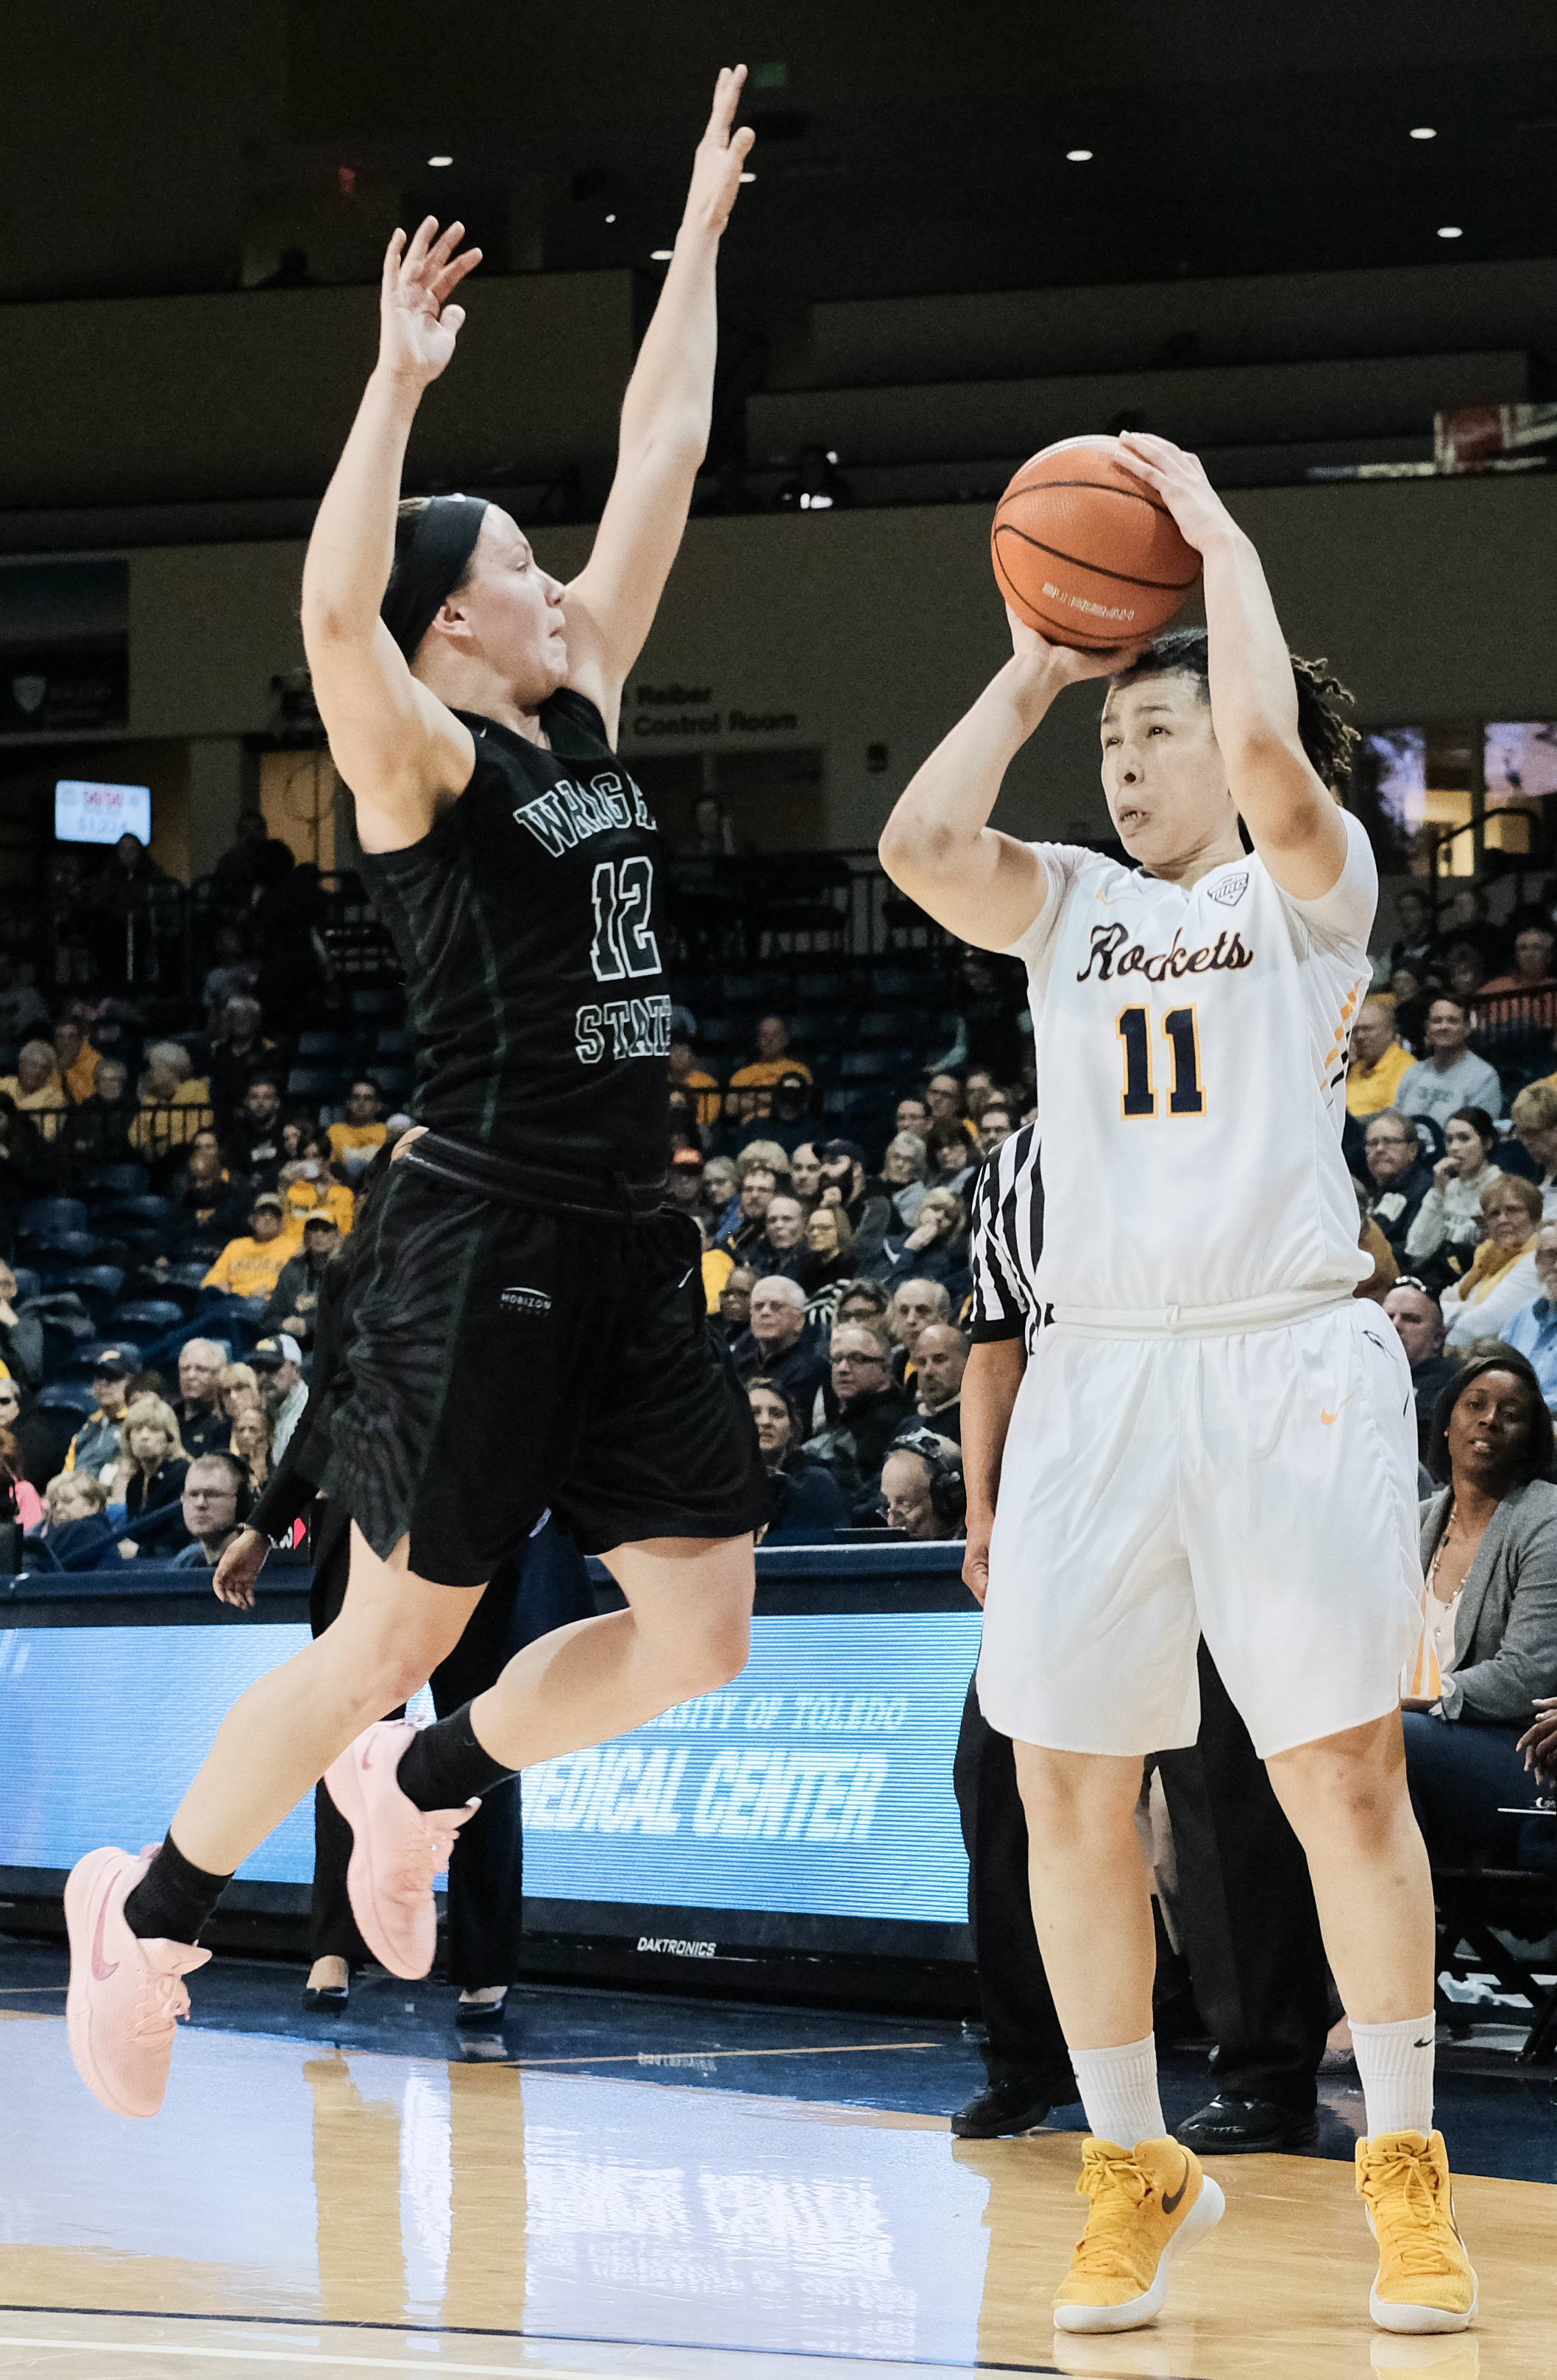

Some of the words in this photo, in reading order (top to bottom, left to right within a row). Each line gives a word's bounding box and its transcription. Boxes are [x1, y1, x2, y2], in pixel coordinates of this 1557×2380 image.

[634, 713, 720, 736] Control
[729, 709, 797, 731] Room
[590, 856, 662, 982] 12
[1077, 922, 1253, 982] Rockets
[1115, 1003, 1207, 1119] 11
[501, 1293, 551, 1310] HORIZON
[792, 1695, 908, 1732] TOLEDO
[696, 1748, 890, 1841] CENTER
[637, 1936, 717, 1957] DAKTRONICS
